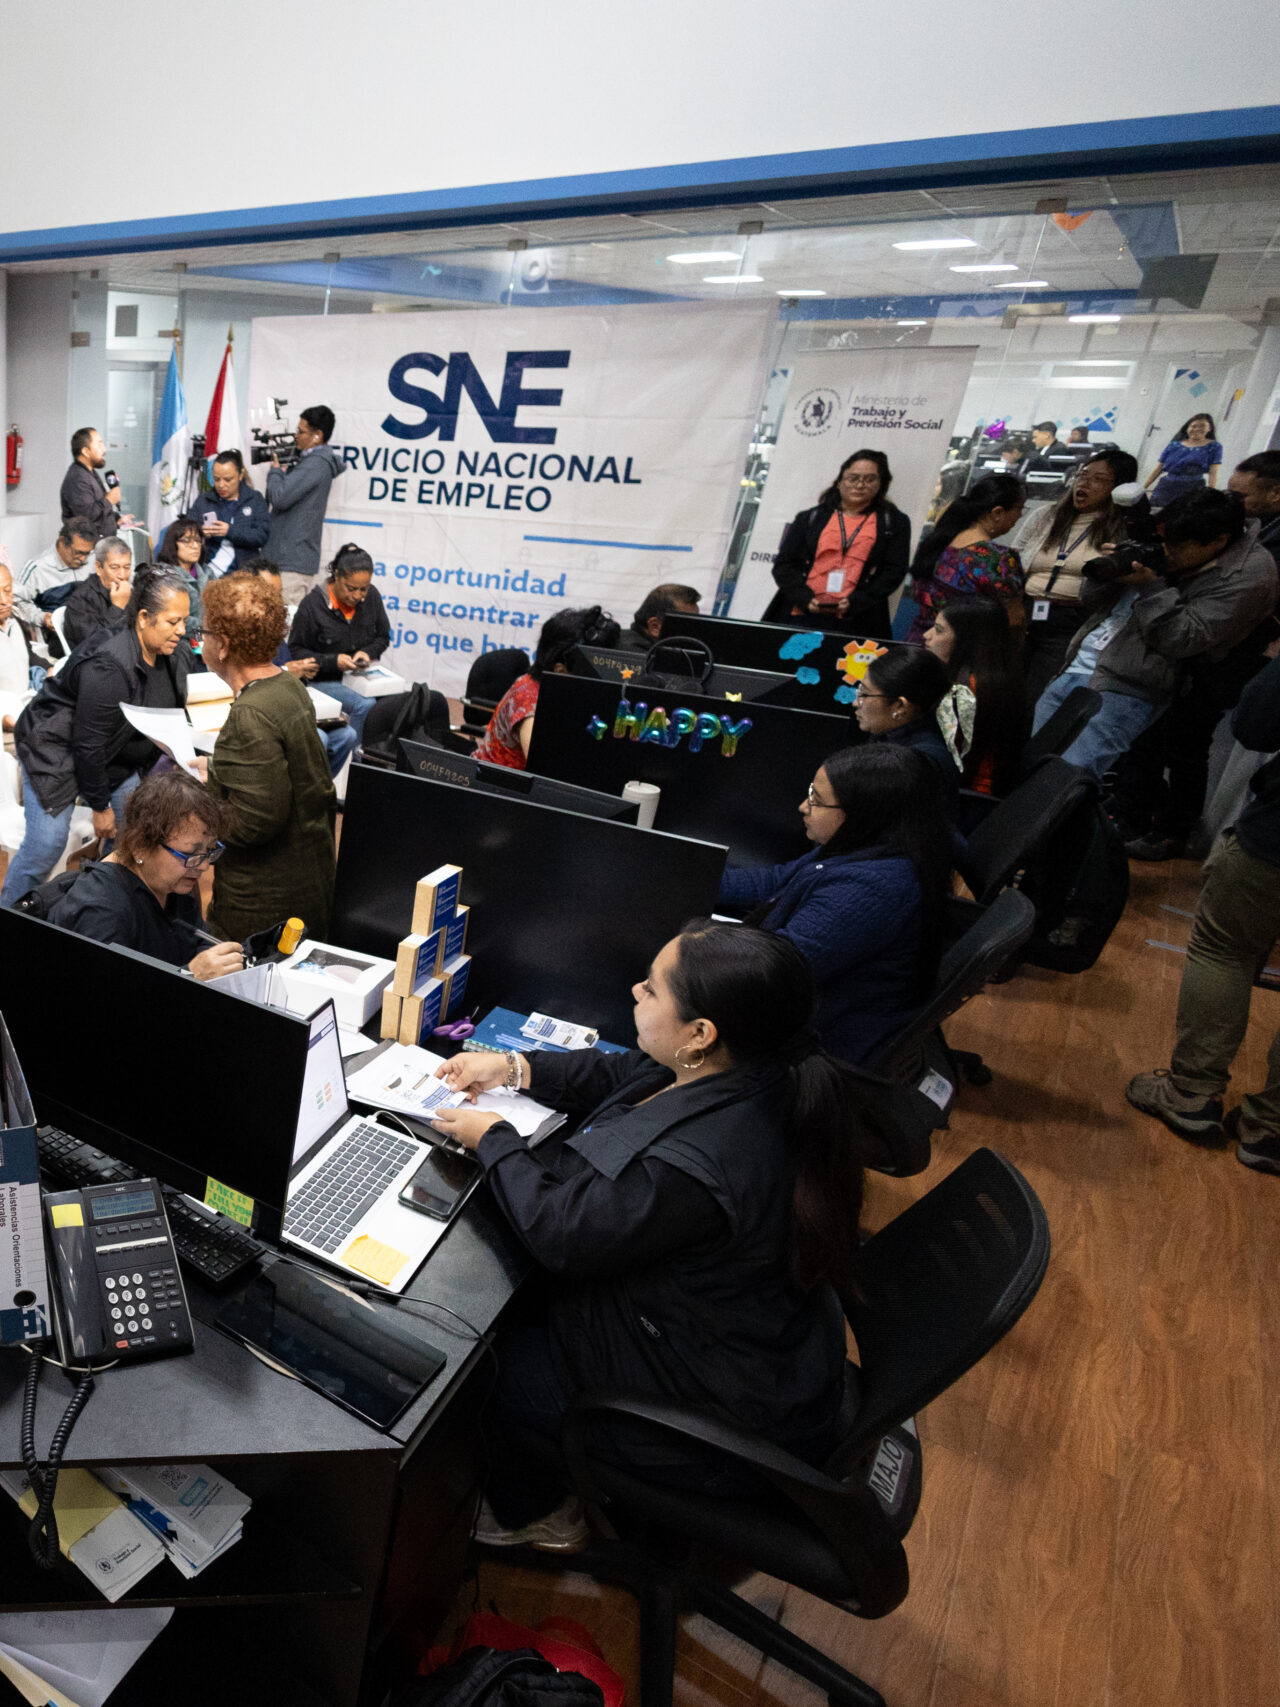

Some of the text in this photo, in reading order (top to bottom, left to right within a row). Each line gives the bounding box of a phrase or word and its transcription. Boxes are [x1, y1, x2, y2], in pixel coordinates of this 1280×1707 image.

[380, 350, 572, 445] SNE
[852, 407, 907, 420] Trabajo y
[911, 395, 928, 406] de
[847, 418, 943, 430] Previsión Social
[330, 445, 643, 486] RVICIO NACIONAL
[368, 477, 552, 513] DE EMPLEO
[394, 563, 567, 597] oportunidad
[407, 597, 540, 629] encontrar
[426, 633, 474, 654] que
[613, 700, 754, 758] HAPPY
[9, 1186, 22, 1288] Asistencias Orientaciones
[870, 1439, 902, 1500] MAJO
